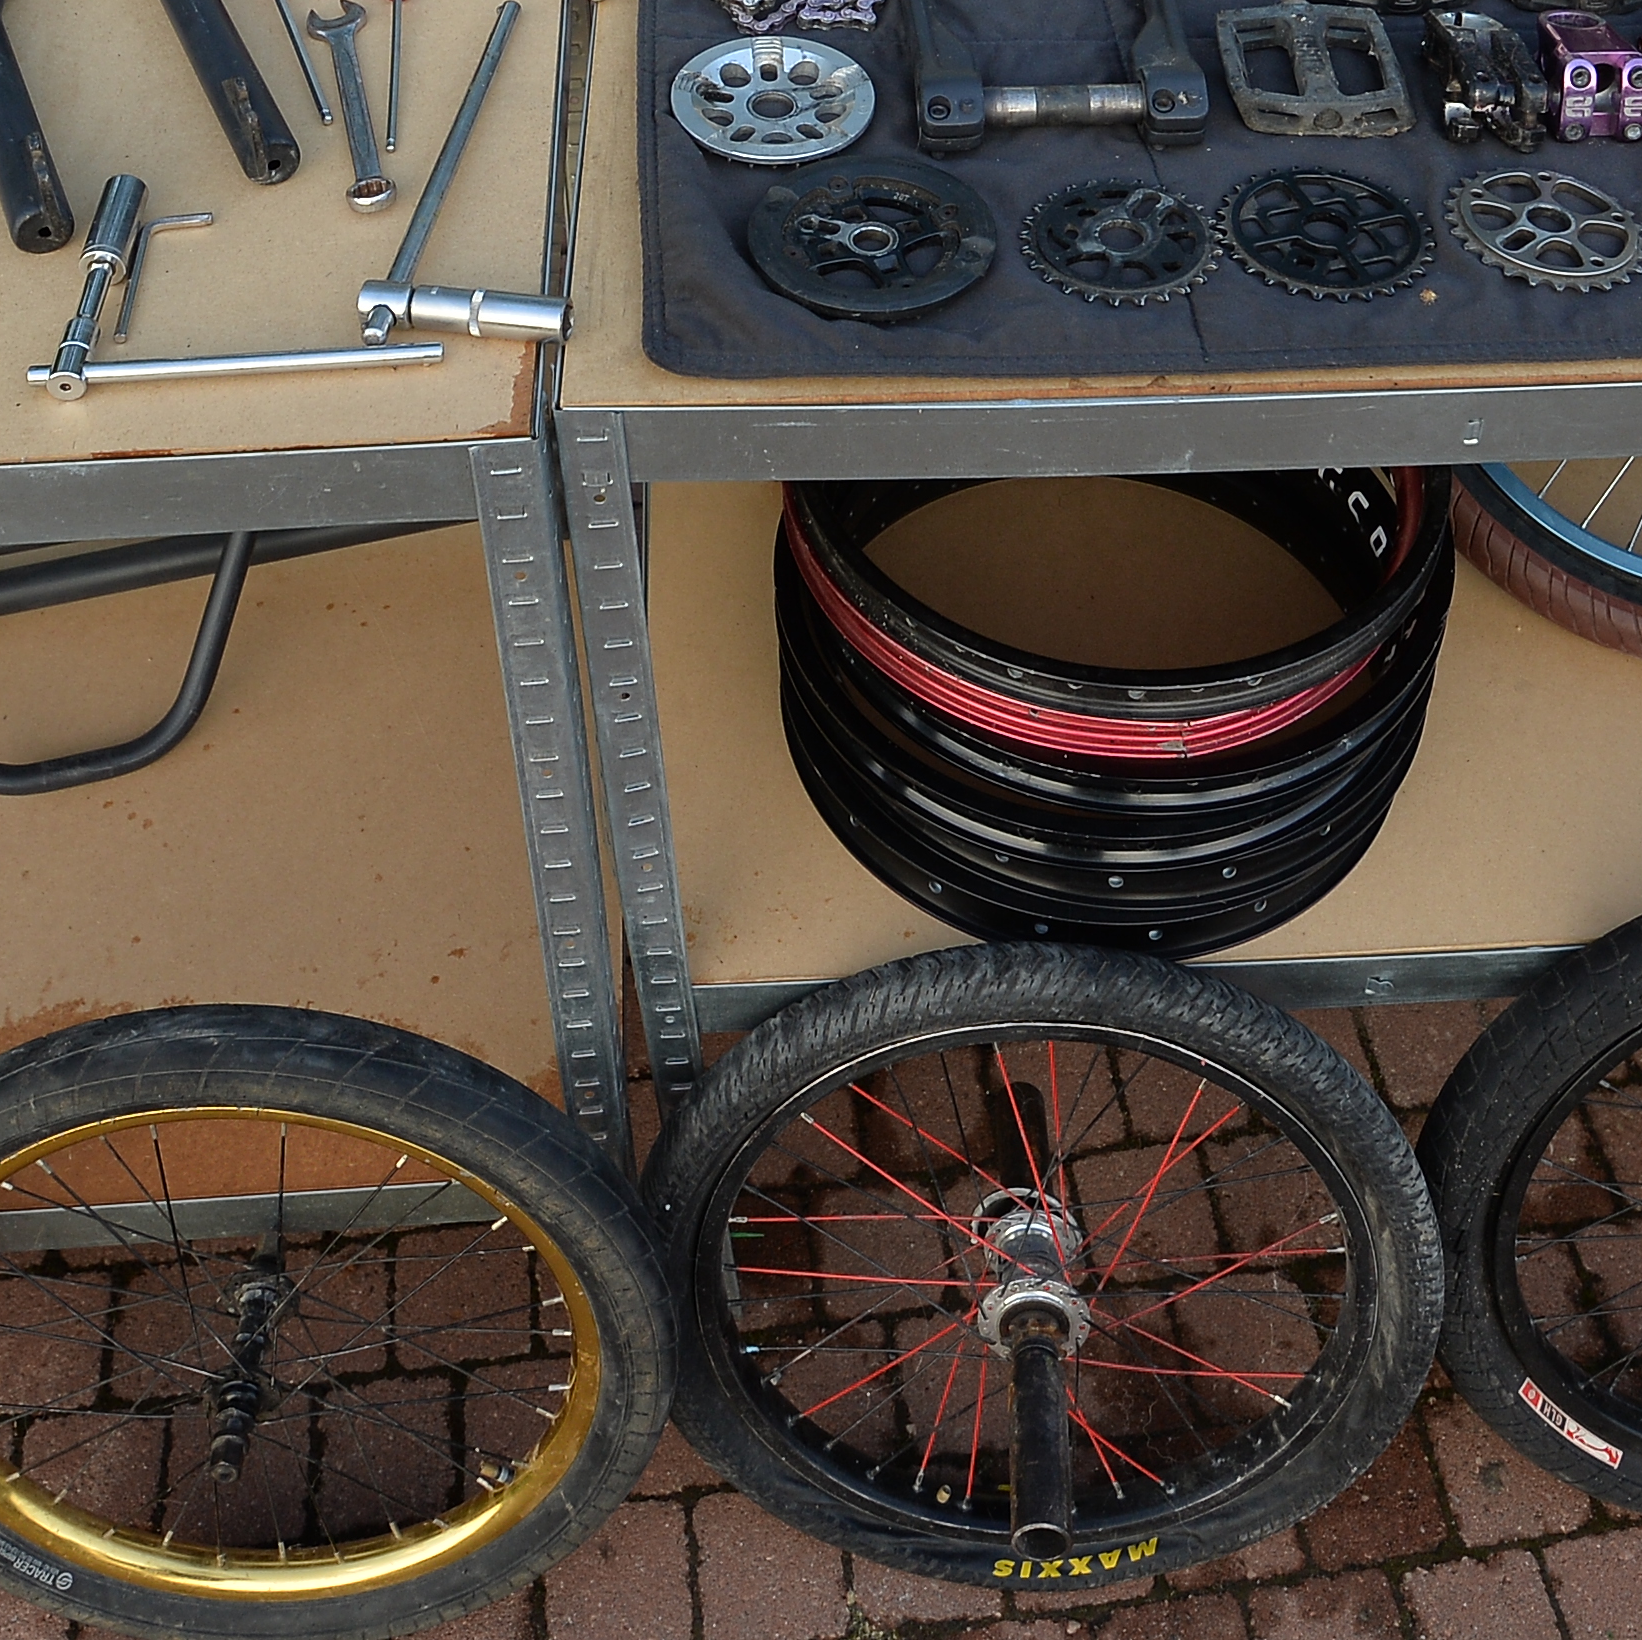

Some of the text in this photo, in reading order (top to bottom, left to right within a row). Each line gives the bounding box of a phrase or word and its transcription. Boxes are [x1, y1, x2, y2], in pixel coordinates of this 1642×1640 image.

[1543, 1400, 1563, 1427] GLH
[993, 1536, 1159, 1579] MAXXIS
[13, 1558, 57, 1586] TRACER
